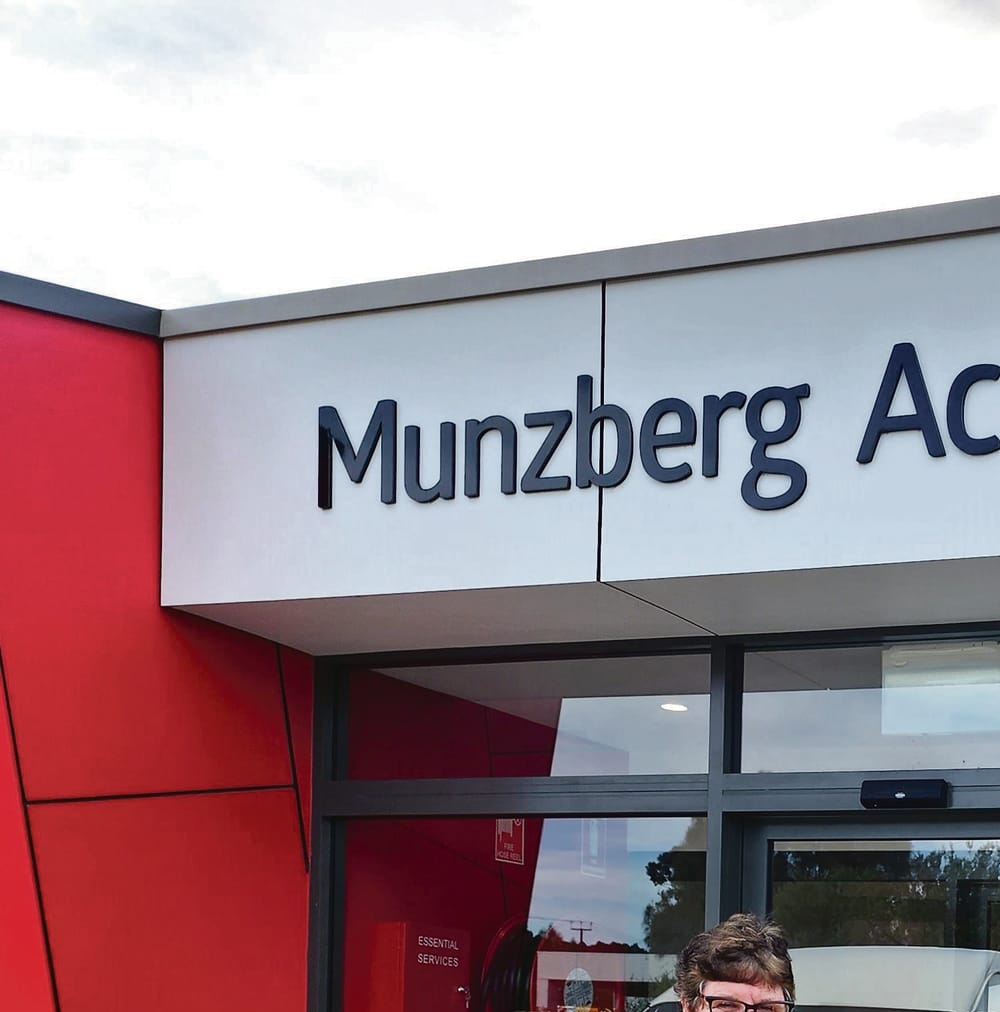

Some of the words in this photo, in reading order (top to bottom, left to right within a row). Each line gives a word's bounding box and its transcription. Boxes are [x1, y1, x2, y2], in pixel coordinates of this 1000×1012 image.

[317, 374, 811, 511] Munzberg
[417, 935, 460, 951] ESSENTIAL
[417, 953, 460, 968] SERVICES
